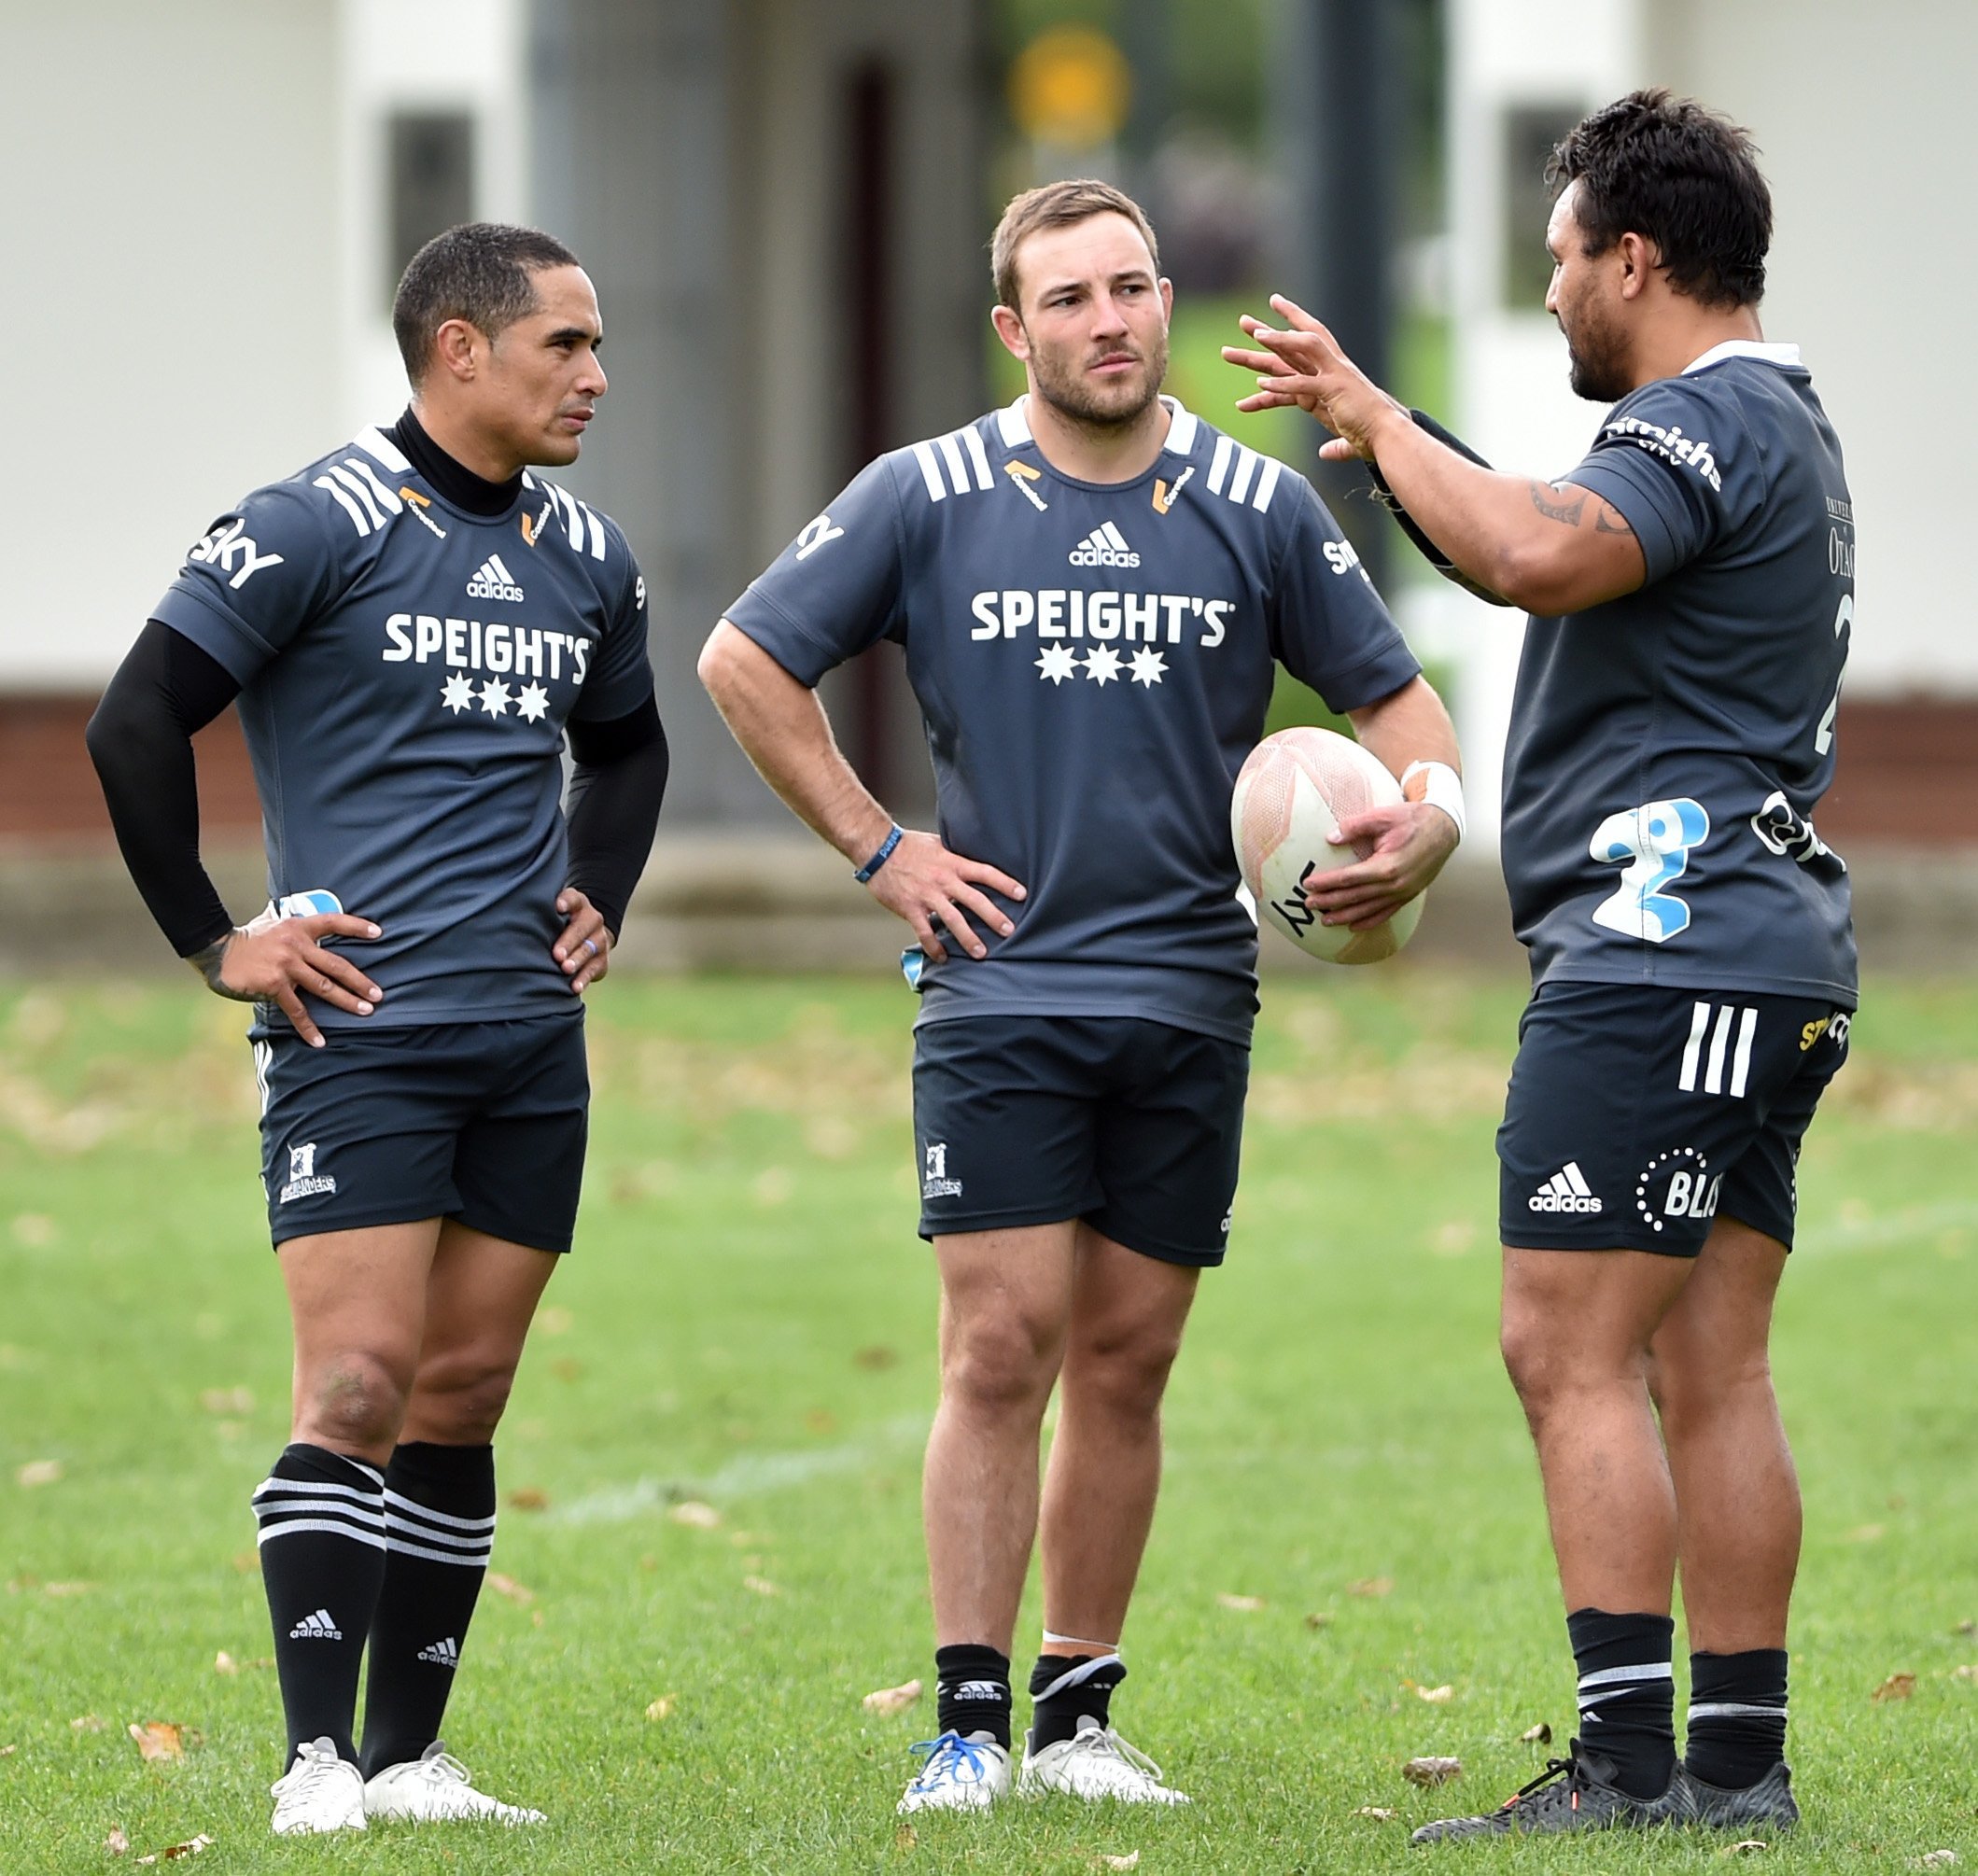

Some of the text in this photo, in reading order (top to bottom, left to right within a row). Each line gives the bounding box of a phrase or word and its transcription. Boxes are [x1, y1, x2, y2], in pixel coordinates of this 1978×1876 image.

[1069, 546, 1141, 567] adidas
[466, 581, 524, 602] adidas
[971, 590, 1228, 648] SPEIGHT'S
[382, 613, 589, 685] SPEIGHT'S
[1528, 1194, 1603, 1212] adidas
[289, 1626, 343, 1641] adidas
[953, 1690, 1003, 1701] adidas
